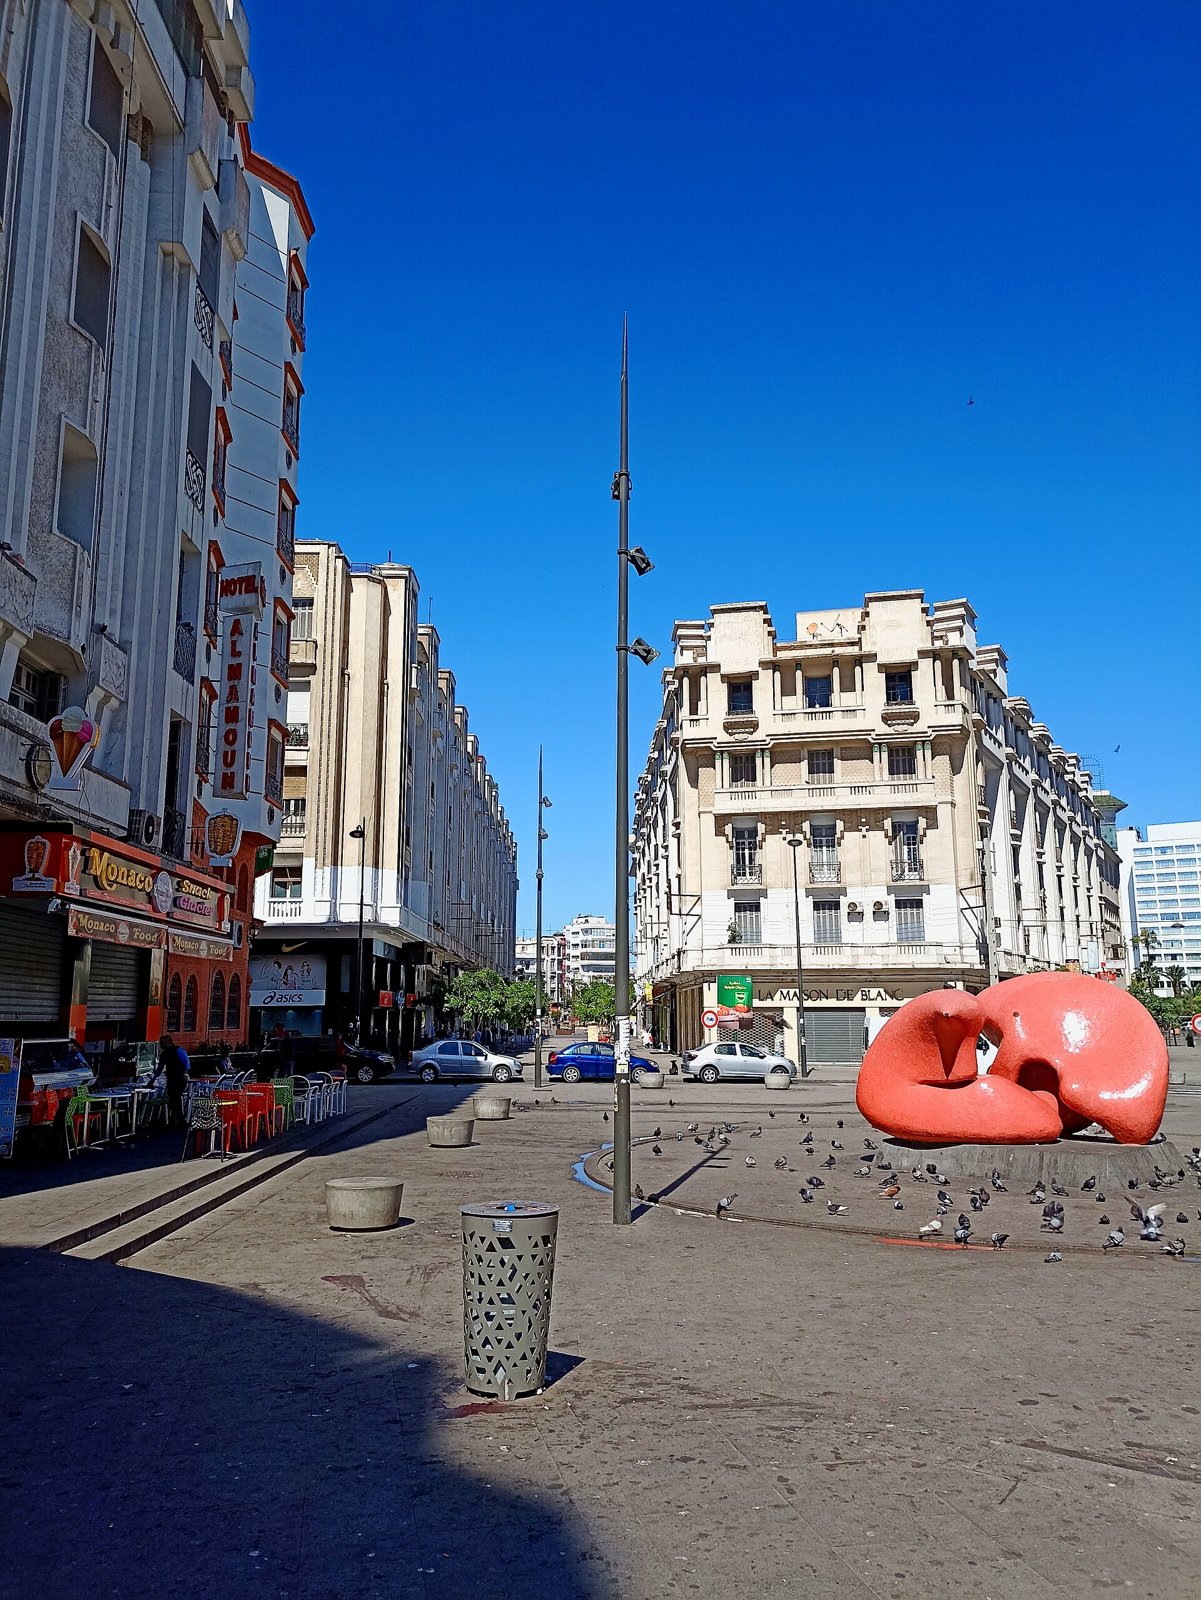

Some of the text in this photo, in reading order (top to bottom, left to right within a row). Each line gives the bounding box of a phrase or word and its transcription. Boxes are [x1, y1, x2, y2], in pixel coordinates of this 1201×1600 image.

[220, 574, 258, 597] HOTEL
[89, 847, 153, 892] Monaco
[78, 913, 115, 934] Monaco
[133, 927, 158, 942] Food
[174, 936, 199, 951] Monaco
[276, 993, 303, 1003] asics
[758, 989, 904, 1001] LA MASON DE BLANC
